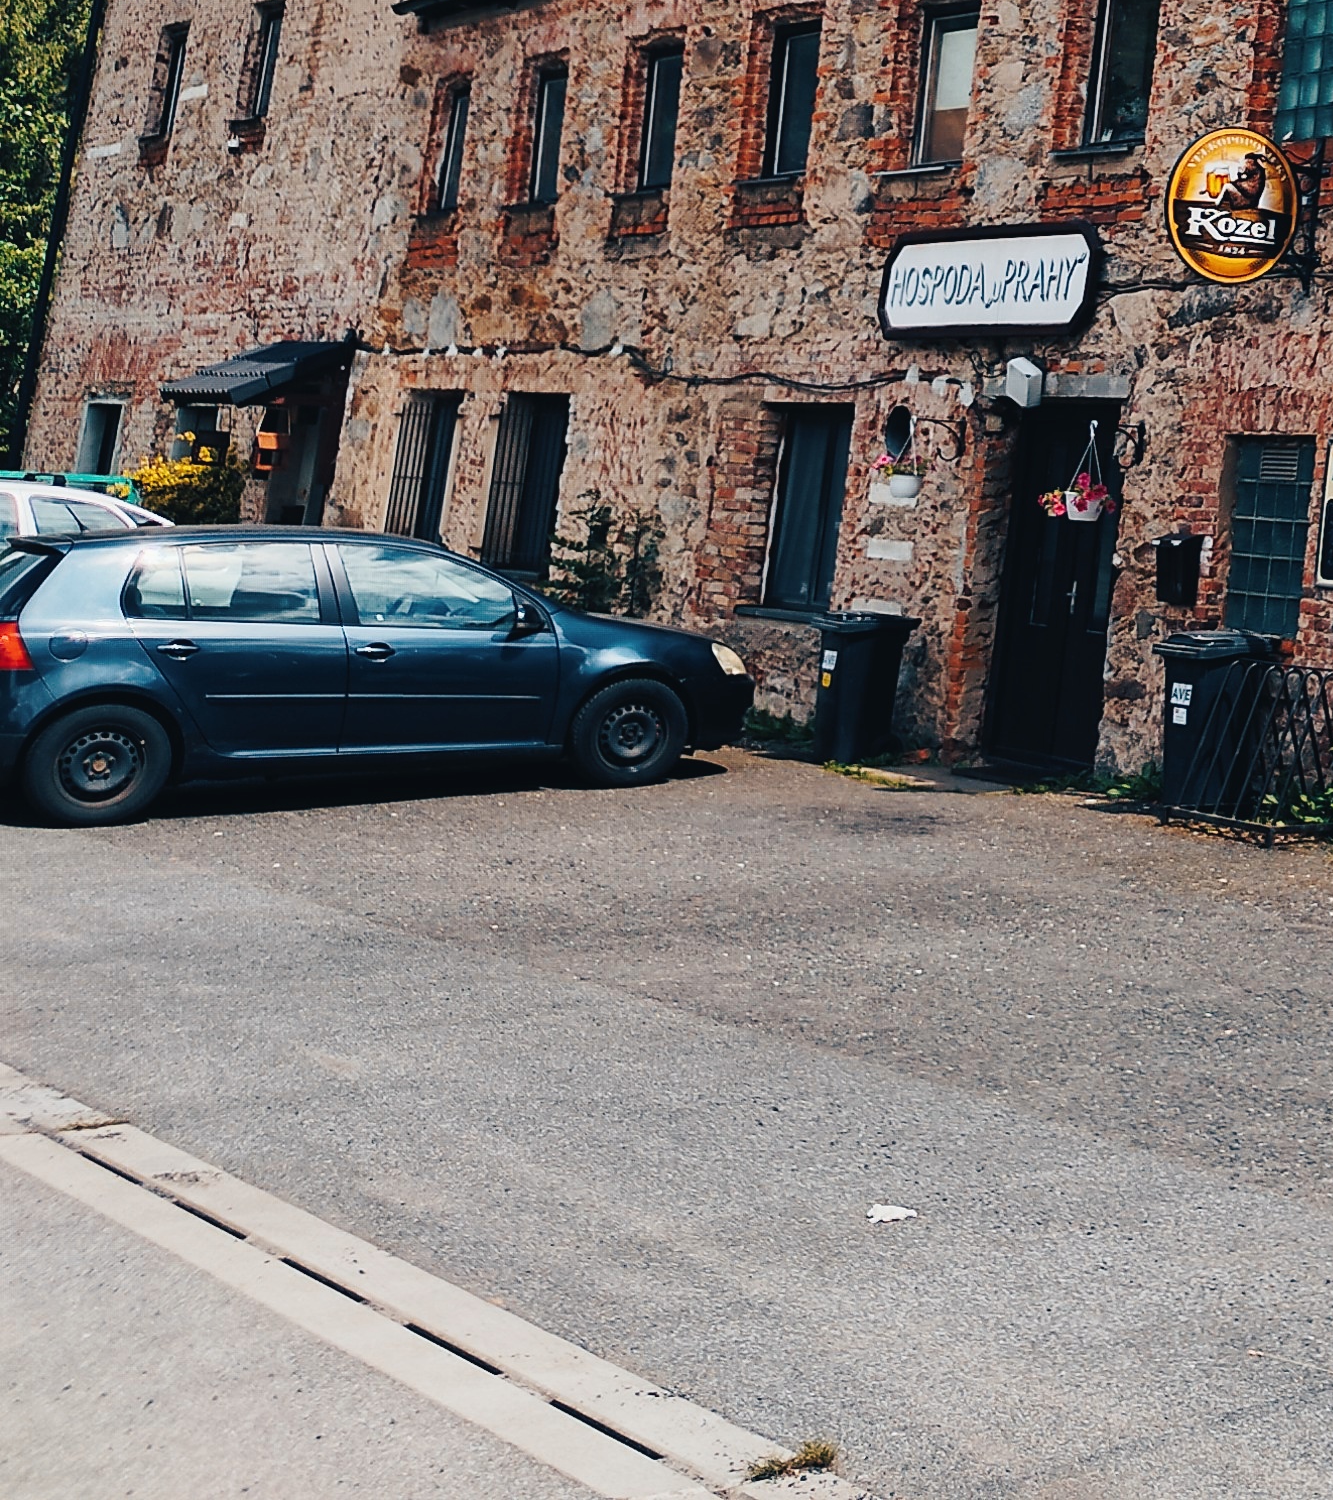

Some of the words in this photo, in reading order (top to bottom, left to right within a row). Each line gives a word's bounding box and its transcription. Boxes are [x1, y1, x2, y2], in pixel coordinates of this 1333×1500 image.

[1185, 207, 1276, 242] Kozel
[890, 262, 985, 308] HOSPODA
[1171, 687, 1192, 701] AVE
